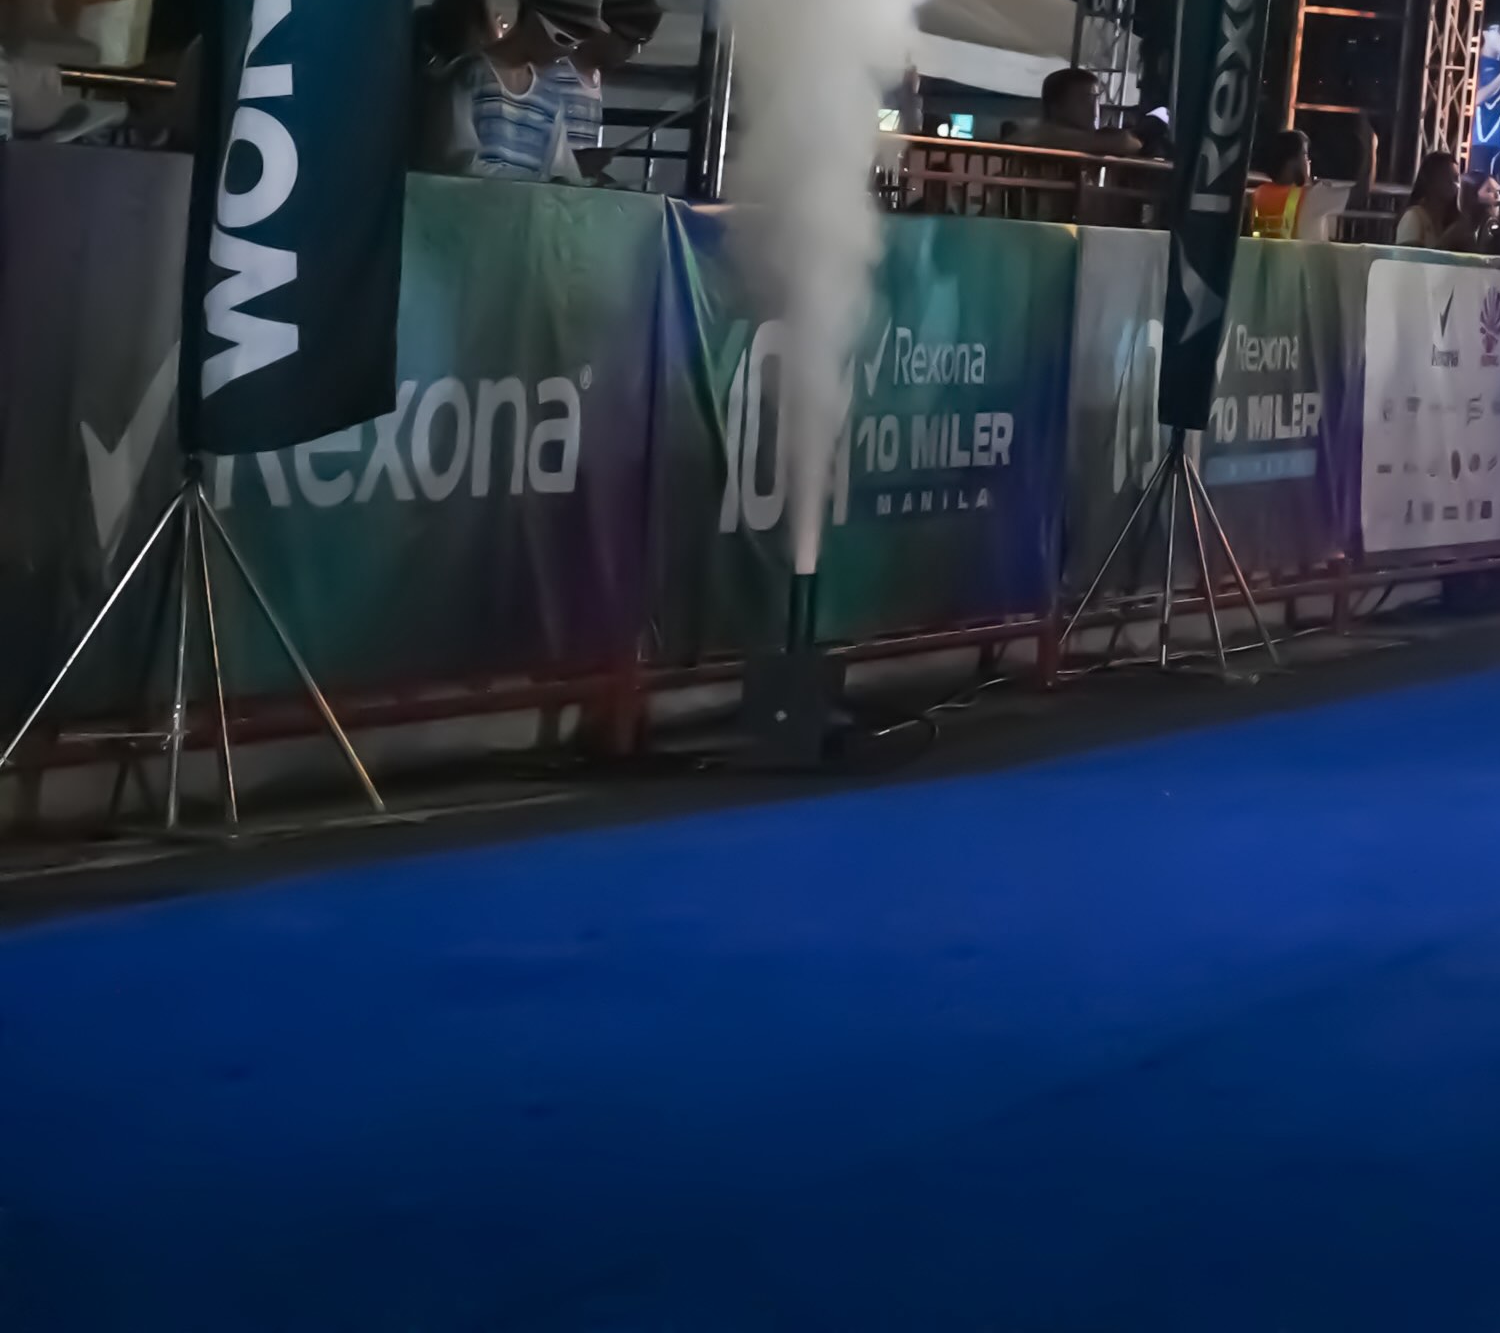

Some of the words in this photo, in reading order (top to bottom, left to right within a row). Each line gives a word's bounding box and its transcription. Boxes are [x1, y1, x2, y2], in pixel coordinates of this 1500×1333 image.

[893, 325, 986, 387] Rexona
[856, 414, 898, 475] 10
[910, 411, 1015, 470] MILER
[1248, 391, 1322, 440] MILER
[876, 487, 993, 515] MANILA
